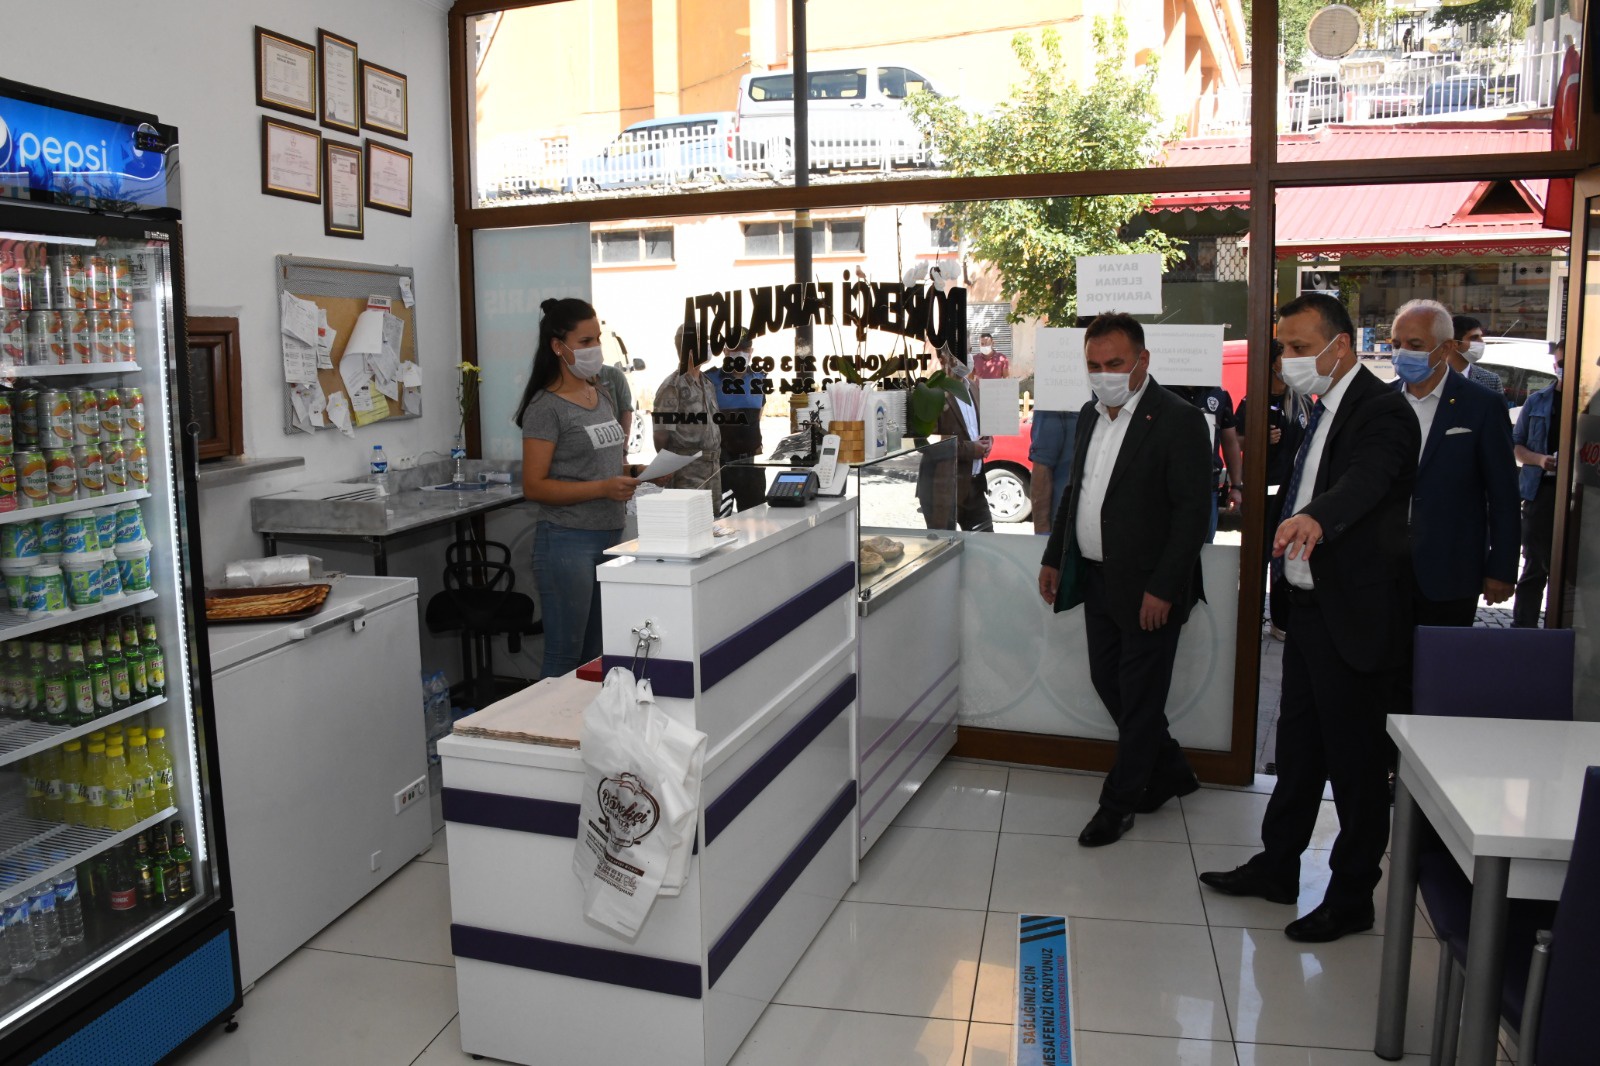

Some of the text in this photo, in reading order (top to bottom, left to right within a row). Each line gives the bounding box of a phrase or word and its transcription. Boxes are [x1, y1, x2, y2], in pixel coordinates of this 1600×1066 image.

[19, 132, 108, 173] pepsi
[1020, 966, 1038, 1044] SAĞLIĞINIZ İÇİN
[1040, 948, 1056, 1066] MESAFENİZİ KORUYUNUZ
